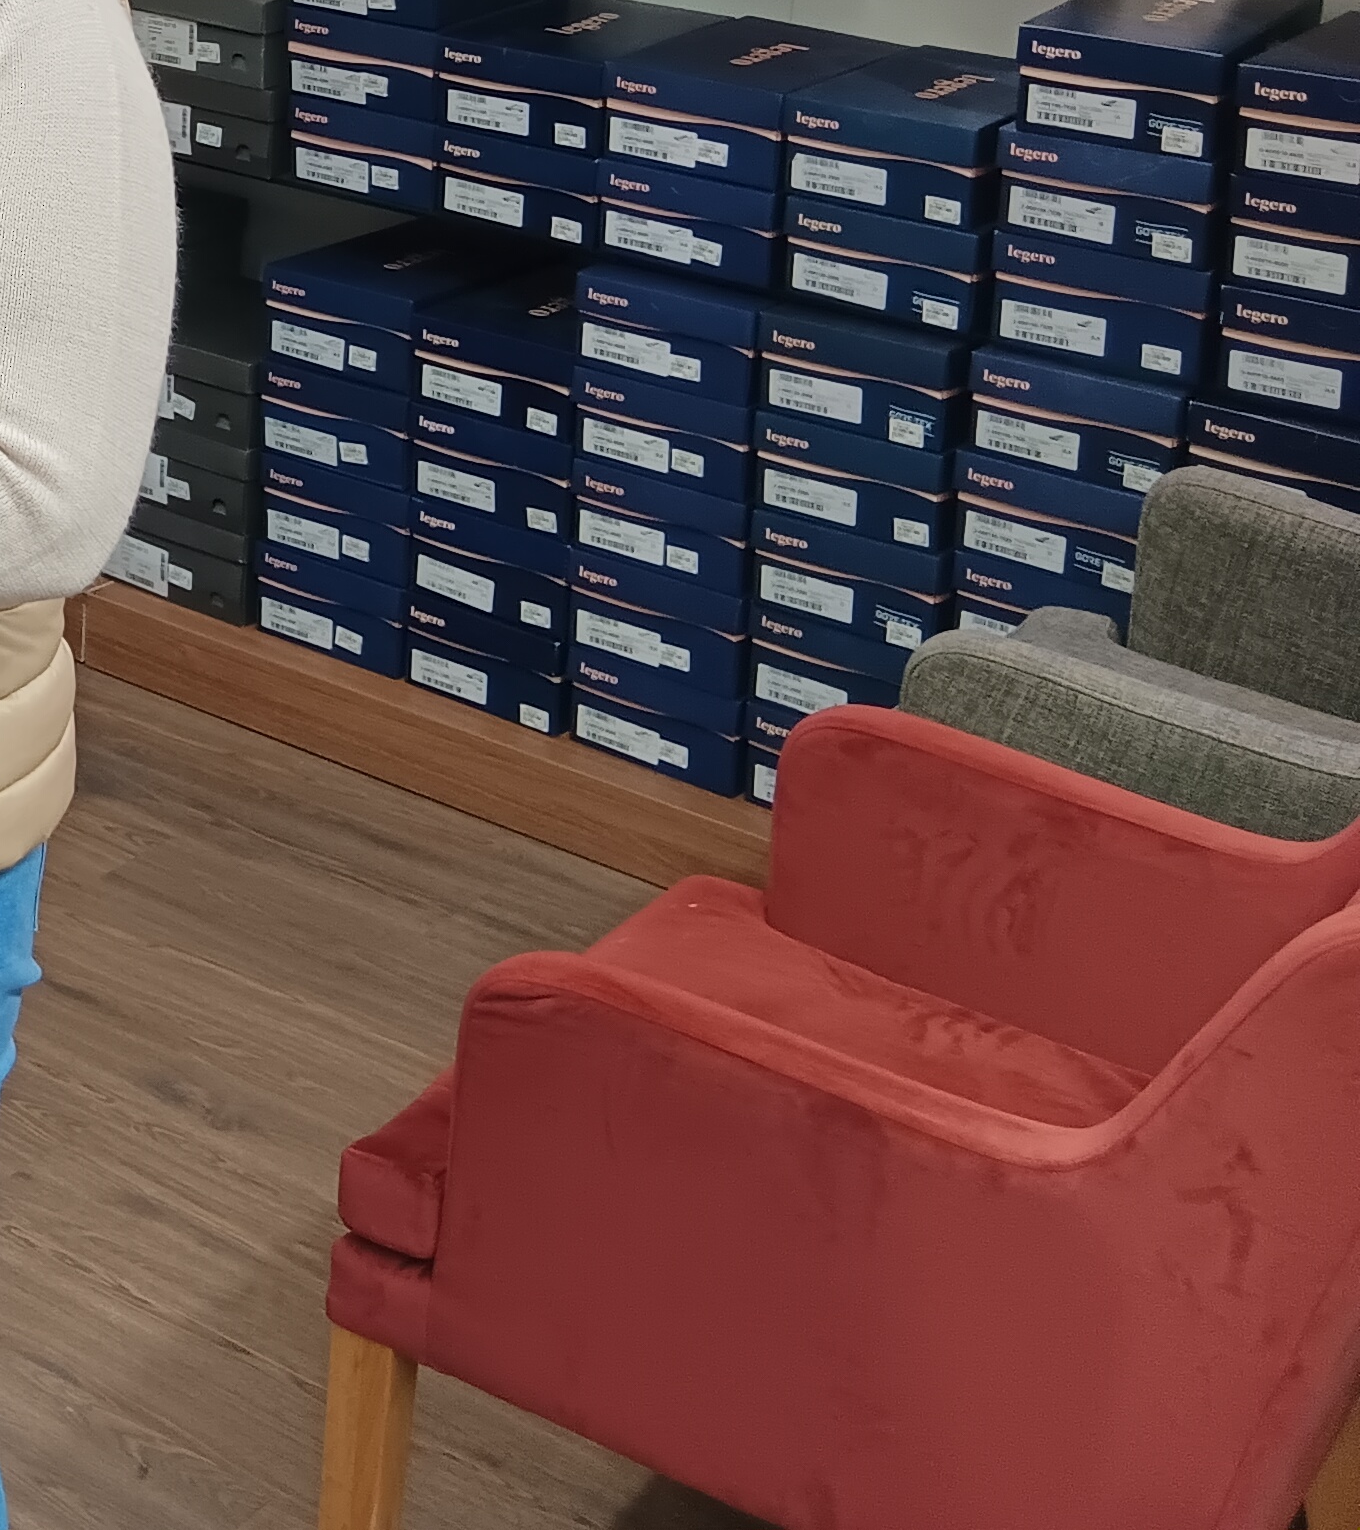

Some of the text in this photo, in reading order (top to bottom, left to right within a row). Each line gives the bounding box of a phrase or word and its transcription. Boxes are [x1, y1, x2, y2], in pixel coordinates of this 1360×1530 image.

[294, 18, 329, 36] legero
[444, 47, 482, 65] legero
[1031, 40, 1082, 62] legero
[616, 76, 657, 95] legero
[1254, 82, 1308, 104] legero
[294, 107, 328, 125] legero
[795, 111, 839, 131] legero
[443, 140, 480, 159] legero
[1009, 142, 1058, 164] legero
[610, 174, 650, 194] legero
[1244, 193, 1297, 215] legero
[797, 213, 842, 234] legero
[1006, 243, 1056, 266] legero
[271, 279, 306, 298] legero
[588, 287, 629, 308] legero
[1236, 304, 1288, 326] legero
[422, 329, 459, 349] legero
[772, 329, 815, 352] legero
[267, 371, 302, 391] legero
[982, 368, 1031, 392] legero
[584, 382, 625, 404] legero
[418, 415, 455, 436] legero
[1204, 419, 1255, 443] legero
[765, 428, 809, 451] legero
[269, 468, 304, 489] legero
[585, 475, 625, 497] legero
[967, 467, 1014, 491] legero
[419, 510, 456, 532] legero
[764, 527, 809, 549] legero
[264, 552, 298, 573] legero
[578, 564, 618, 588] legero
[966, 568, 1013, 592] legero
[410, 605, 446, 628] legero
[760, 615, 803, 639] legero
[580, 662, 619, 686] legero
[756, 716, 791, 737] leger
